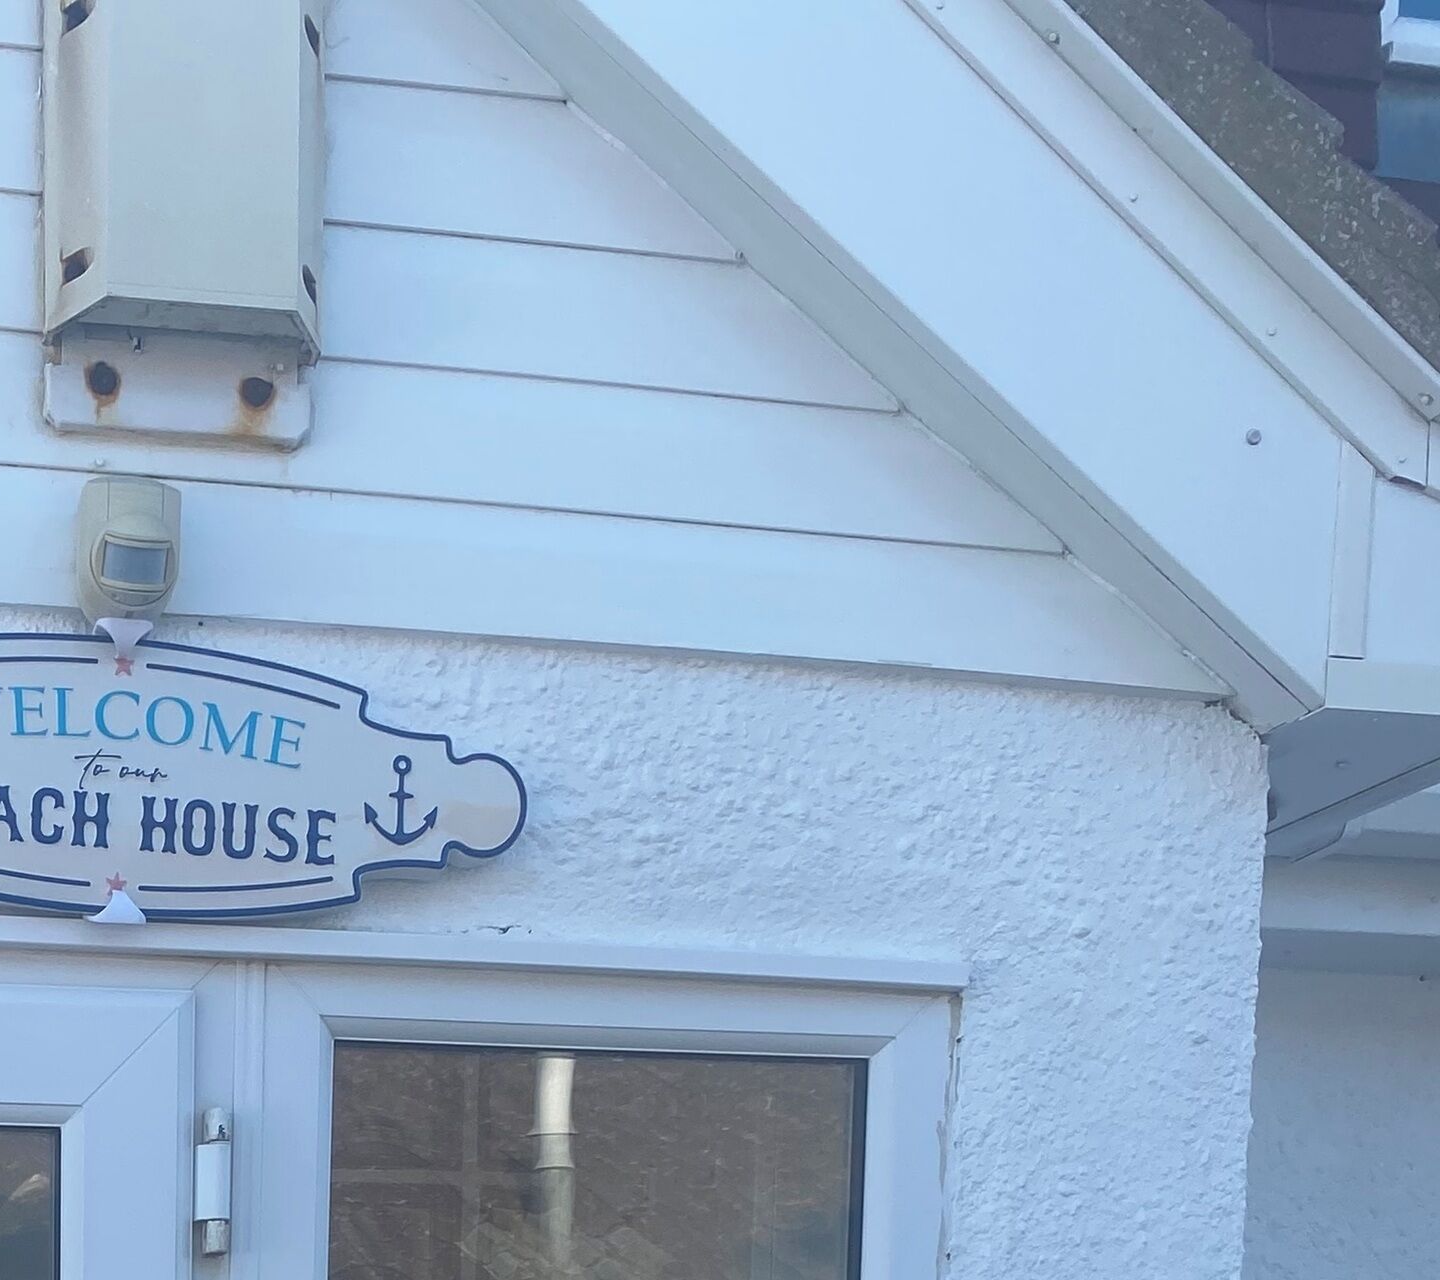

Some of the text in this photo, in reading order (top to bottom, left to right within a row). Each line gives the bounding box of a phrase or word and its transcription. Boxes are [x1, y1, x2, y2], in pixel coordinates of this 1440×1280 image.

[73, 748, 168, 790] to our
[139, 795, 336, 866] HOUSE
